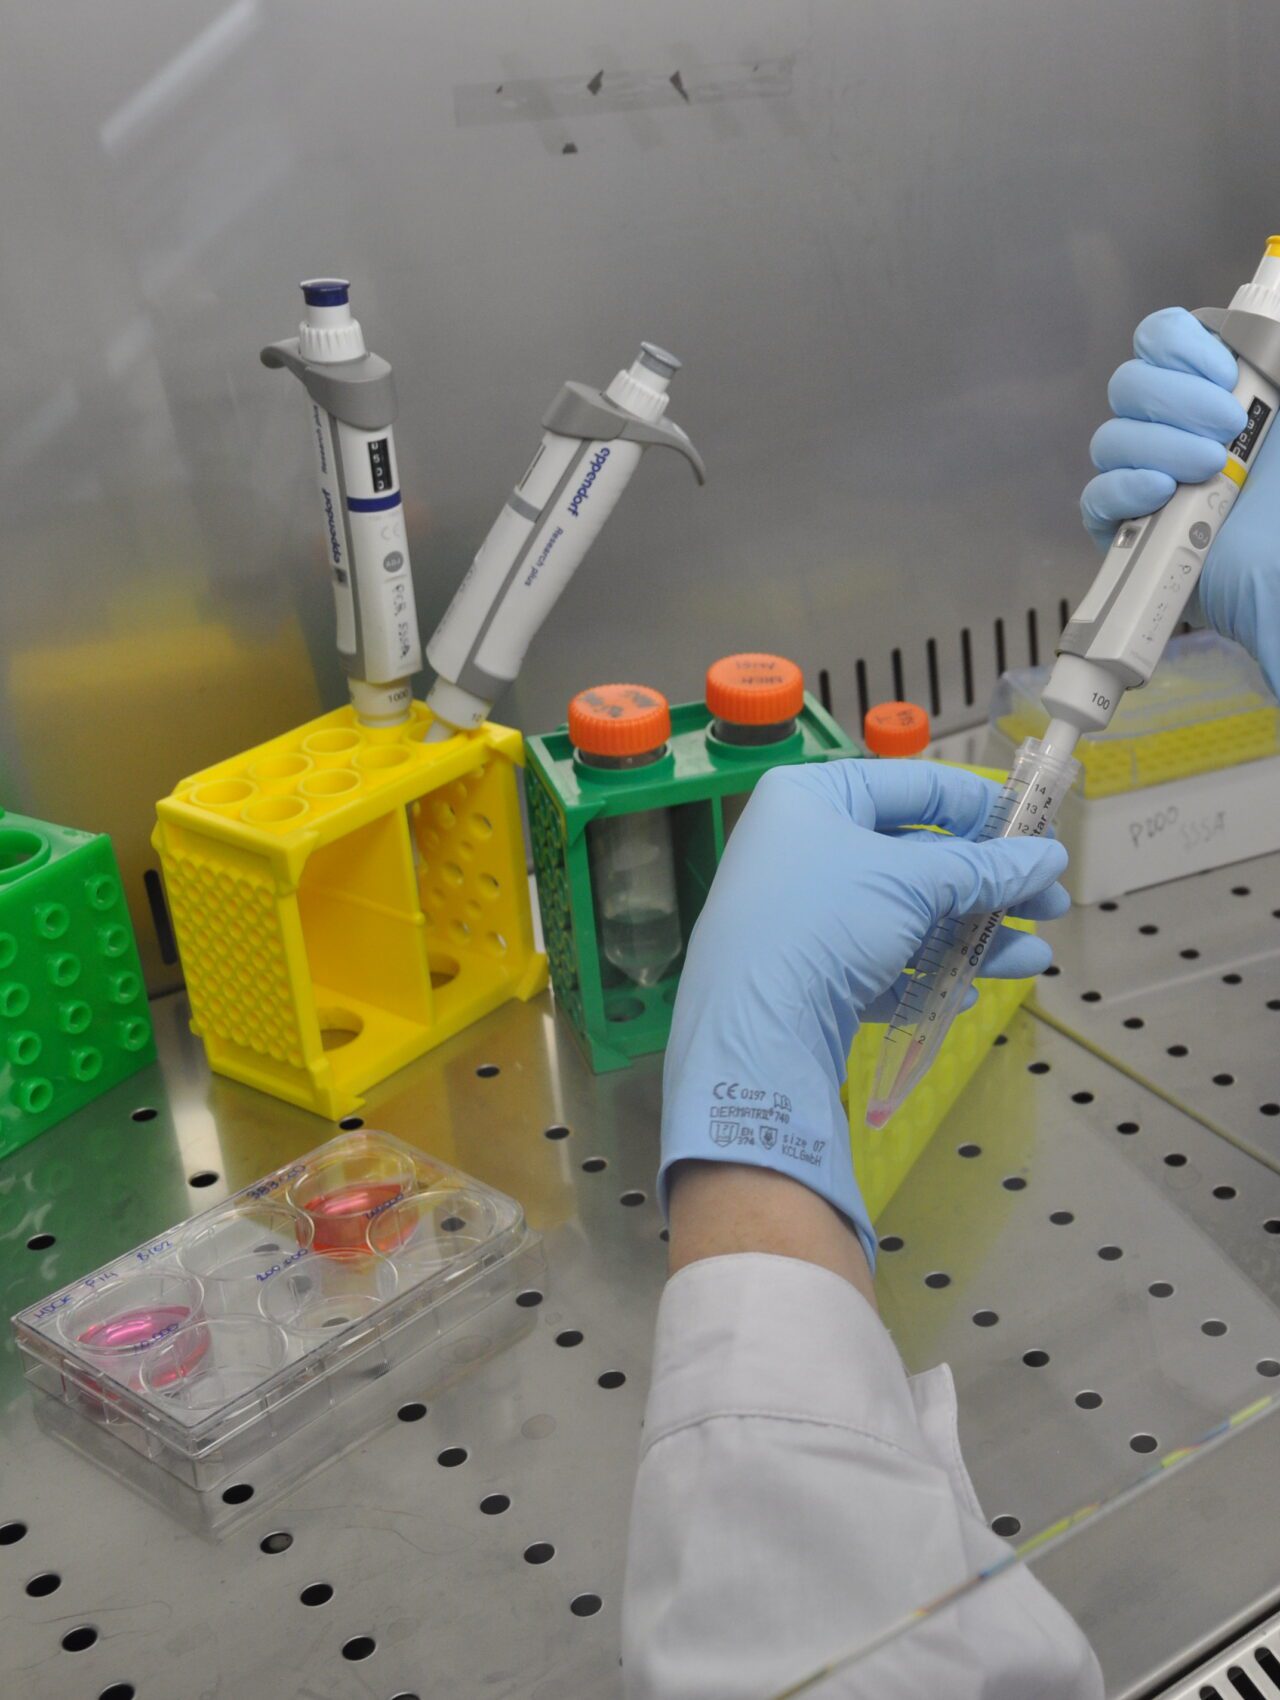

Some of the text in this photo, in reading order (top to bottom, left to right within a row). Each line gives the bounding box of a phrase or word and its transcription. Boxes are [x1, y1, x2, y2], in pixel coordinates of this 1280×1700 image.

[567, 447, 611, 517] eppendorf
[524, 527, 564, 587] Research plus
[1091, 692, 1111, 710] 100
[1034, 783, 1047, 796] 14
[1026, 802, 1039, 815] 13
[1017, 822, 1030, 834] 12
[950, 967, 959, 977] 5
[940, 990, 948, 999] 4
[928, 1012, 937, 1021] 3
[918, 1035, 926, 1045] 2
[740, 1088, 767, 1101] 0197
[783, 1132, 826, 1153] size 07
